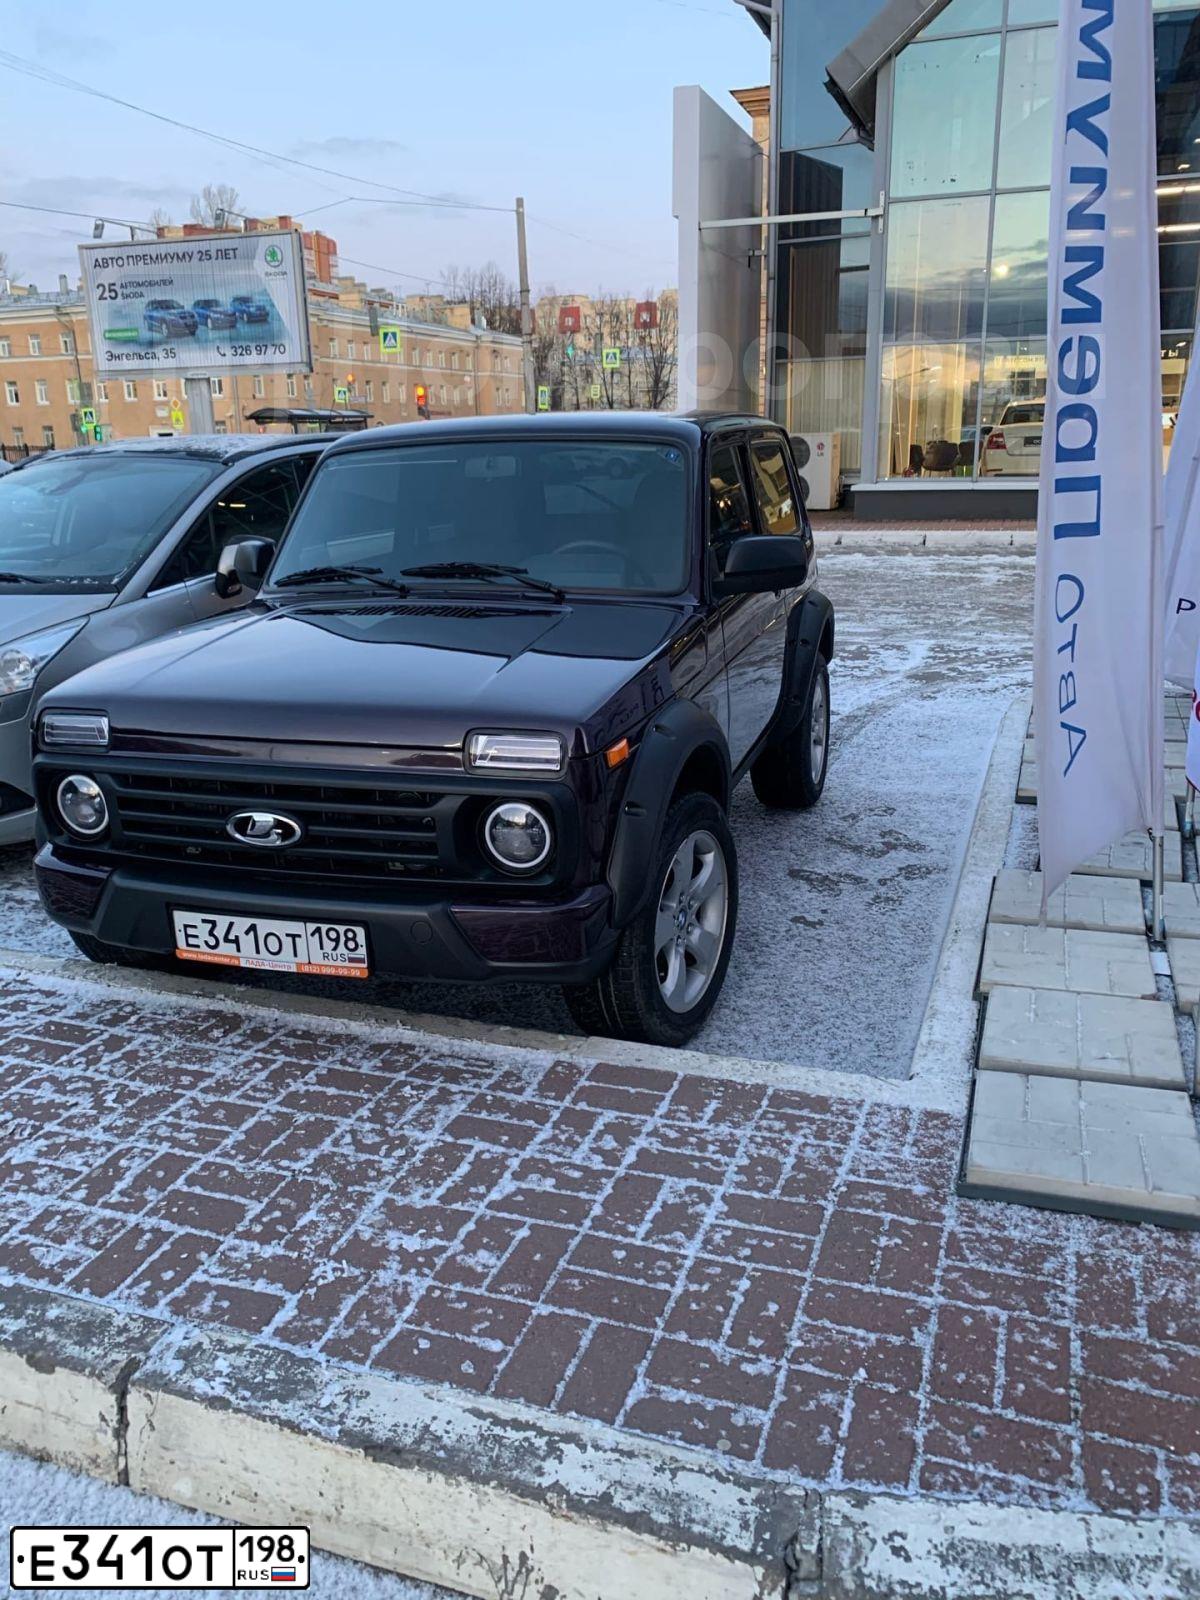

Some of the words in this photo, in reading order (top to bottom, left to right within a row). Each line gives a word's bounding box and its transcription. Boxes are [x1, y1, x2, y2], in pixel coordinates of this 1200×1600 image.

[93, 257, 126, 269] АВТО
[127, 251, 194, 266] ПРЕМИУМУ
[197, 249, 213, 262] 25
[215, 247, 239, 261] ЛЕТ
[96, 283, 119, 300] 25
[105, 350, 160, 362] Энгельса,
[162, 348, 177, 360] 35
[231, 346, 253, 357] 326
[255, 345, 269, 356] 97
[271, 344, 286, 355] 70
[309, 926, 358, 952] 198
[322, 952, 347, 963] RUS
[245, 959, 292, 970] ЛАДА-Центр
[301, 964, 320, 975] (812)
